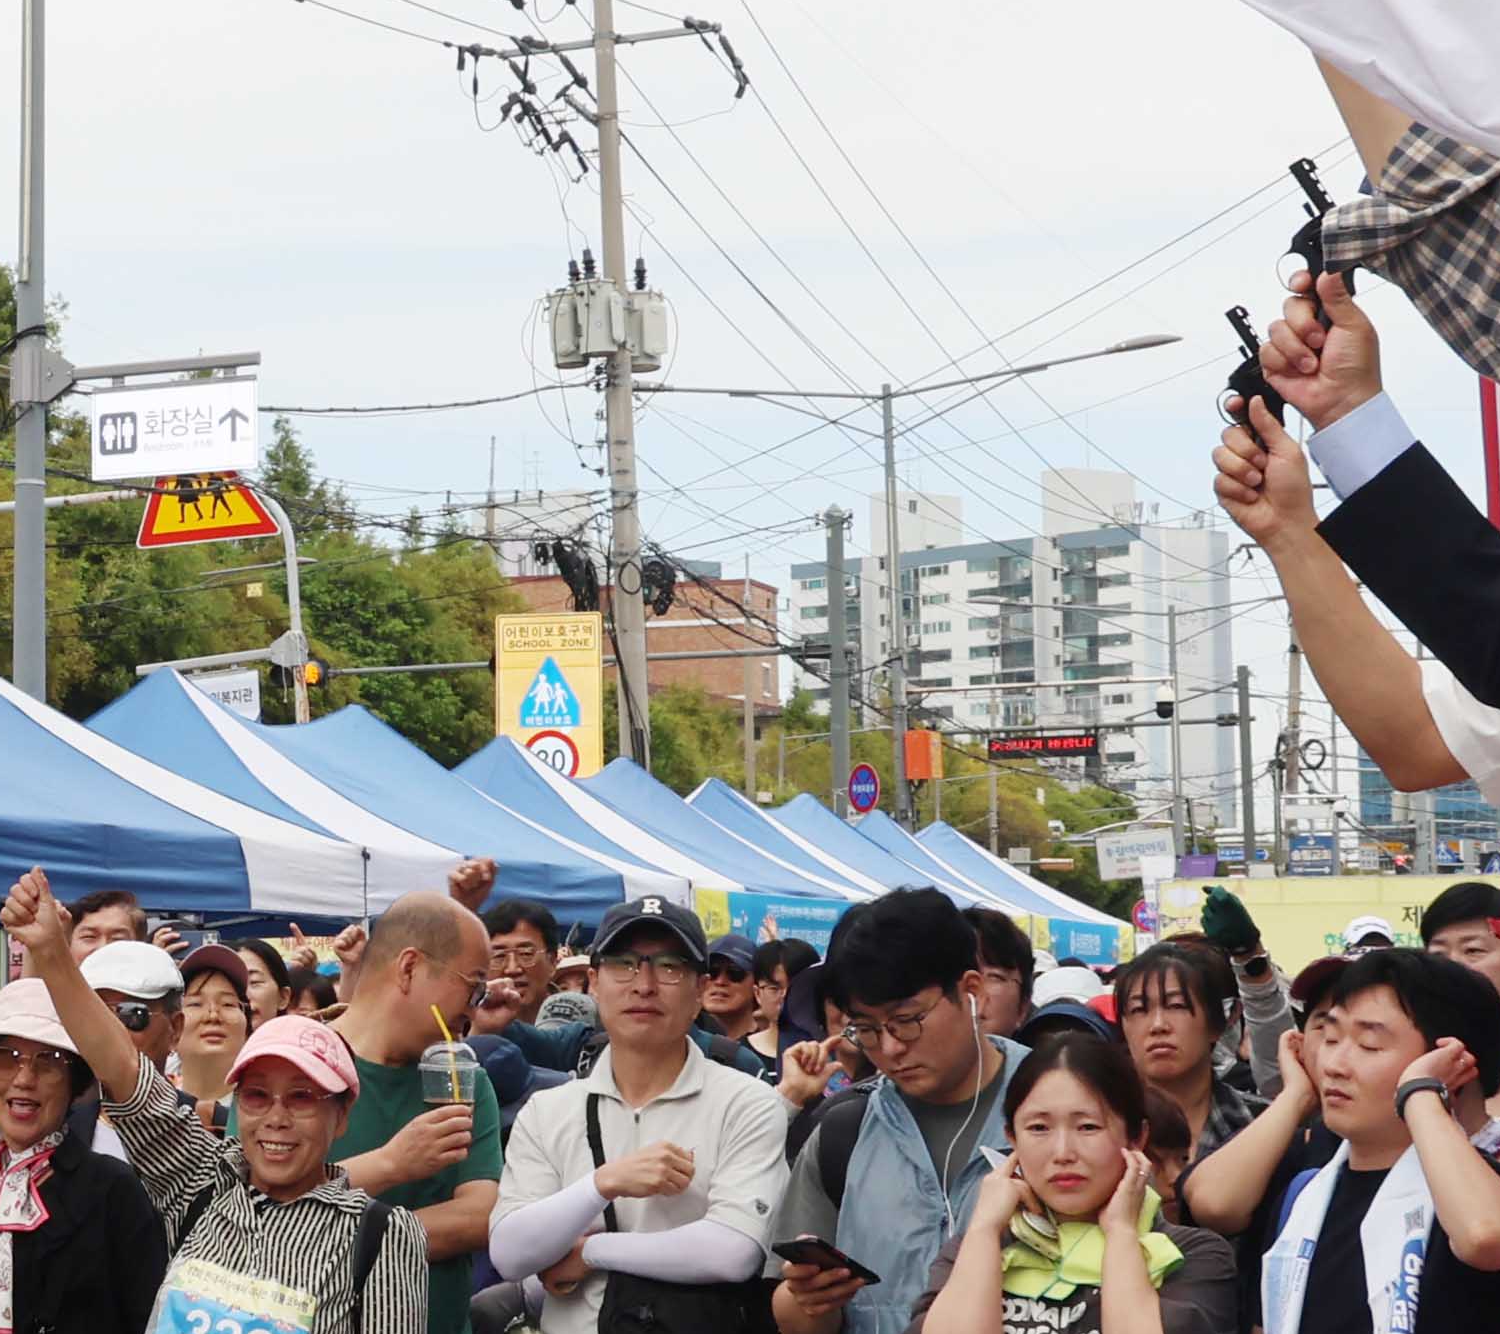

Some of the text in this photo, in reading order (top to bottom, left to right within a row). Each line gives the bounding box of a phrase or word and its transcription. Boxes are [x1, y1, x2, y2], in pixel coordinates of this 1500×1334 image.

[143, 404, 214, 439] 화장실
[505, 624, 594, 639] 어린이보호구역
[508, 637, 591, 649] SCHOOL ZONE
[640, 898, 663, 915] R
